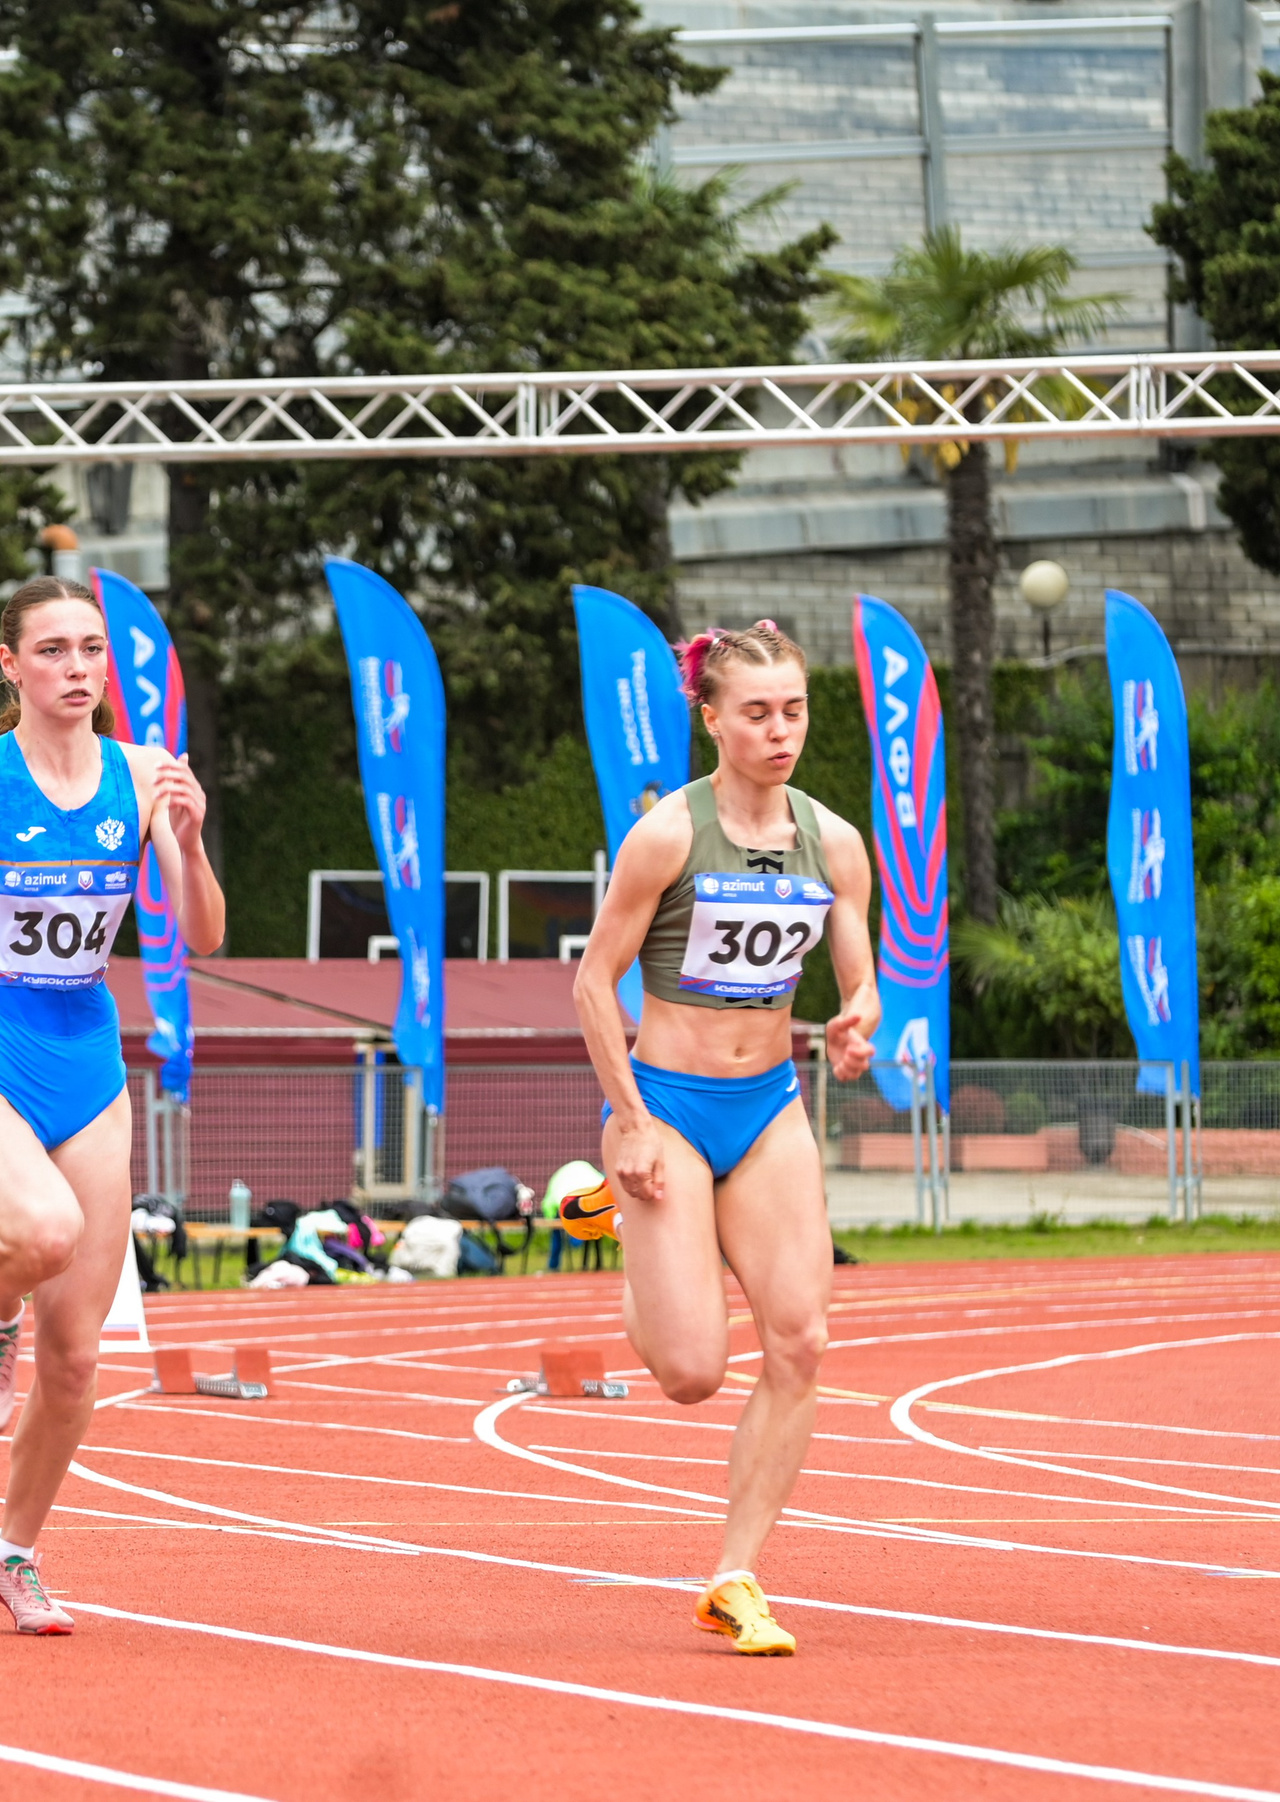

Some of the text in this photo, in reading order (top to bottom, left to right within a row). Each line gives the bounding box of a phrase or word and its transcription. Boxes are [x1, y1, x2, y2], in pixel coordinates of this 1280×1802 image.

[24, 873, 67, 885] azimut
[722, 879, 765, 892] azimut
[9, 911, 108, 959] 304
[708, 920, 811, 967] 302
